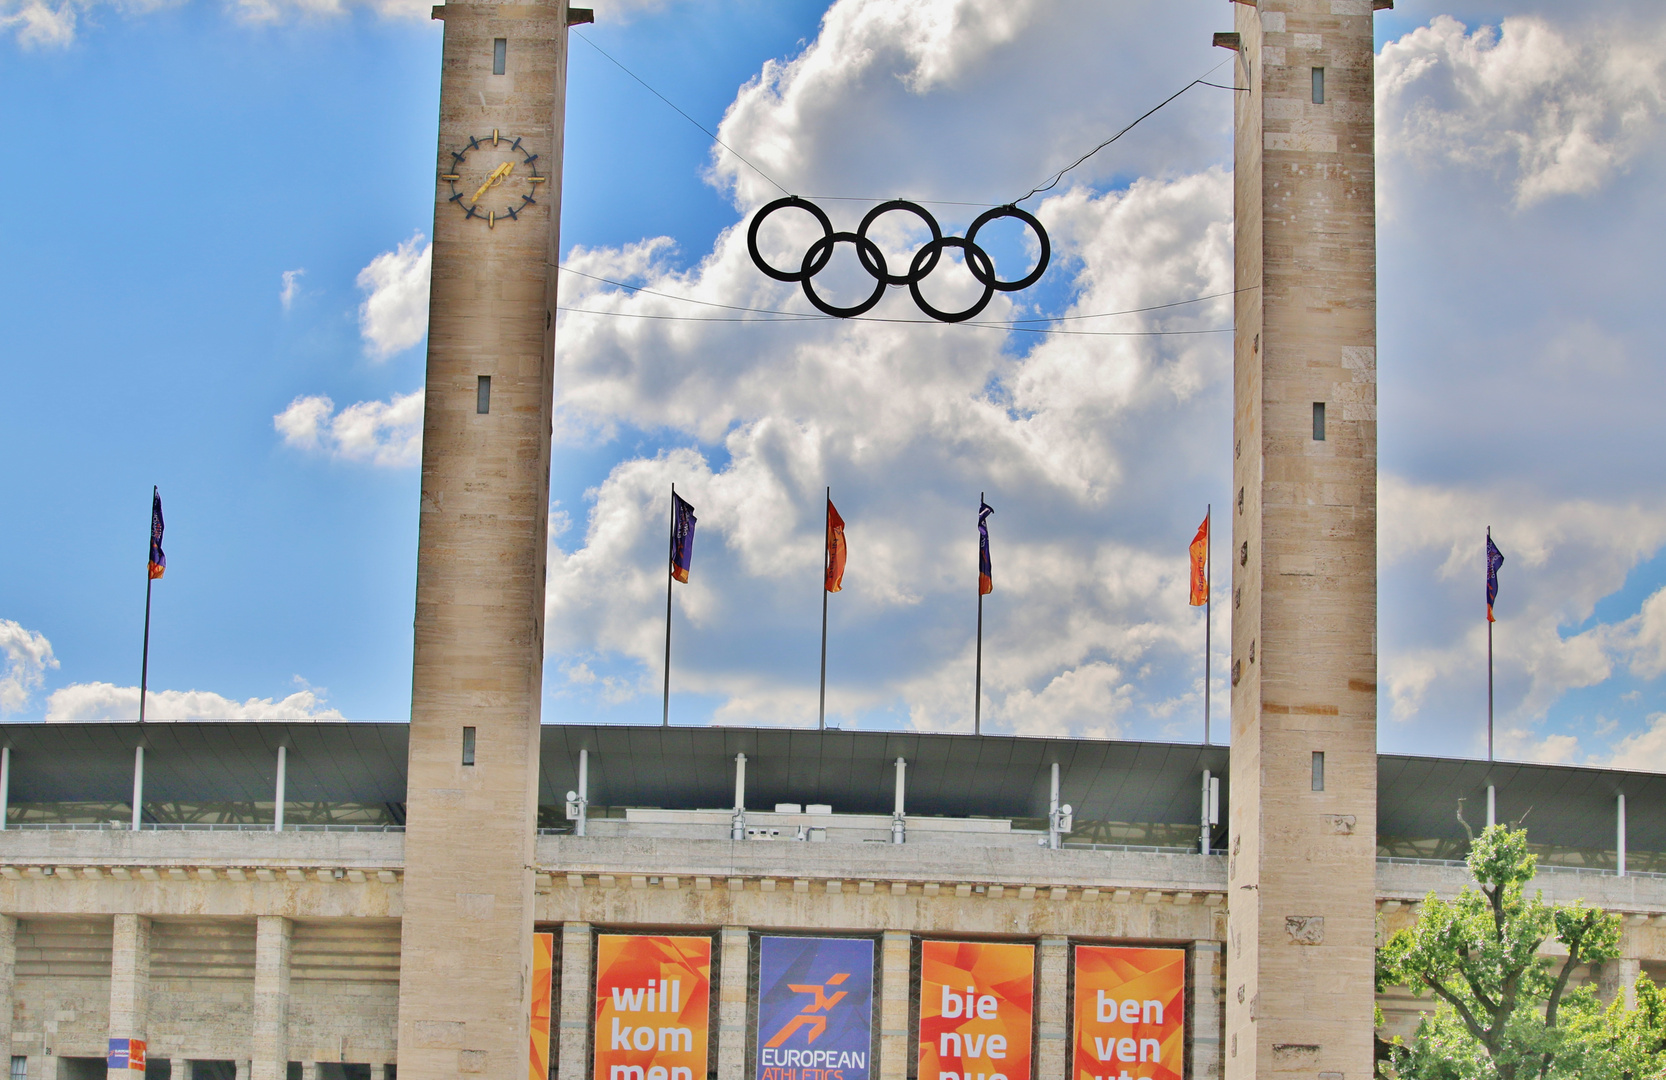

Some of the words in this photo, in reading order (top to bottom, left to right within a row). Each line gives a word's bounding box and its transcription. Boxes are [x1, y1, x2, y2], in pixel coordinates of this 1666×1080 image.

[611, 979, 680, 1012] will
[941, 985, 998, 1020] bie
[1096, 989, 1164, 1024] ben
[611, 1017, 693, 1052] kom
[940, 1032, 1007, 1059] nve
[762, 1048, 865, 1069] EUROPEAN
[1094, 1037, 1161, 1063] ven
[610, 1065, 692, 1080] men
[761, 1067, 844, 1080] ATHLETICS
